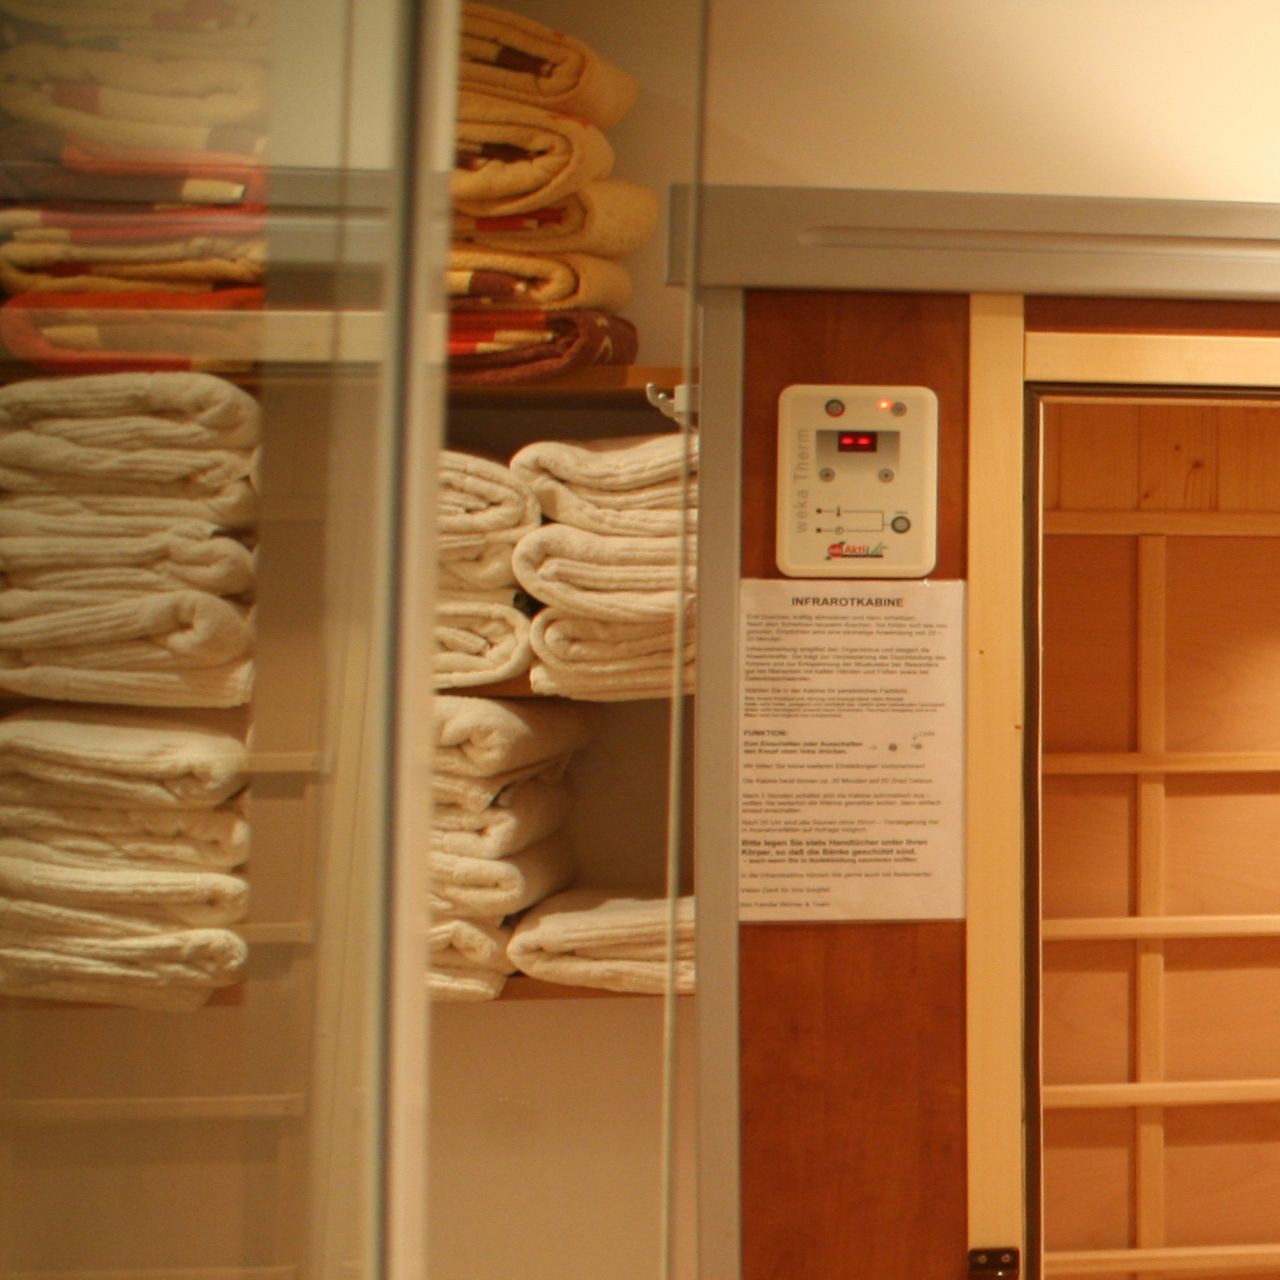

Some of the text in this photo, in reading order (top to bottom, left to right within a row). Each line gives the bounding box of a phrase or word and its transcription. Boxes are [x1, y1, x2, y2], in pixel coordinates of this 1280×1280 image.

[794, 428, 809, 534] weka Therm
[792, 597, 904, 607] INFRAROTKABINE
